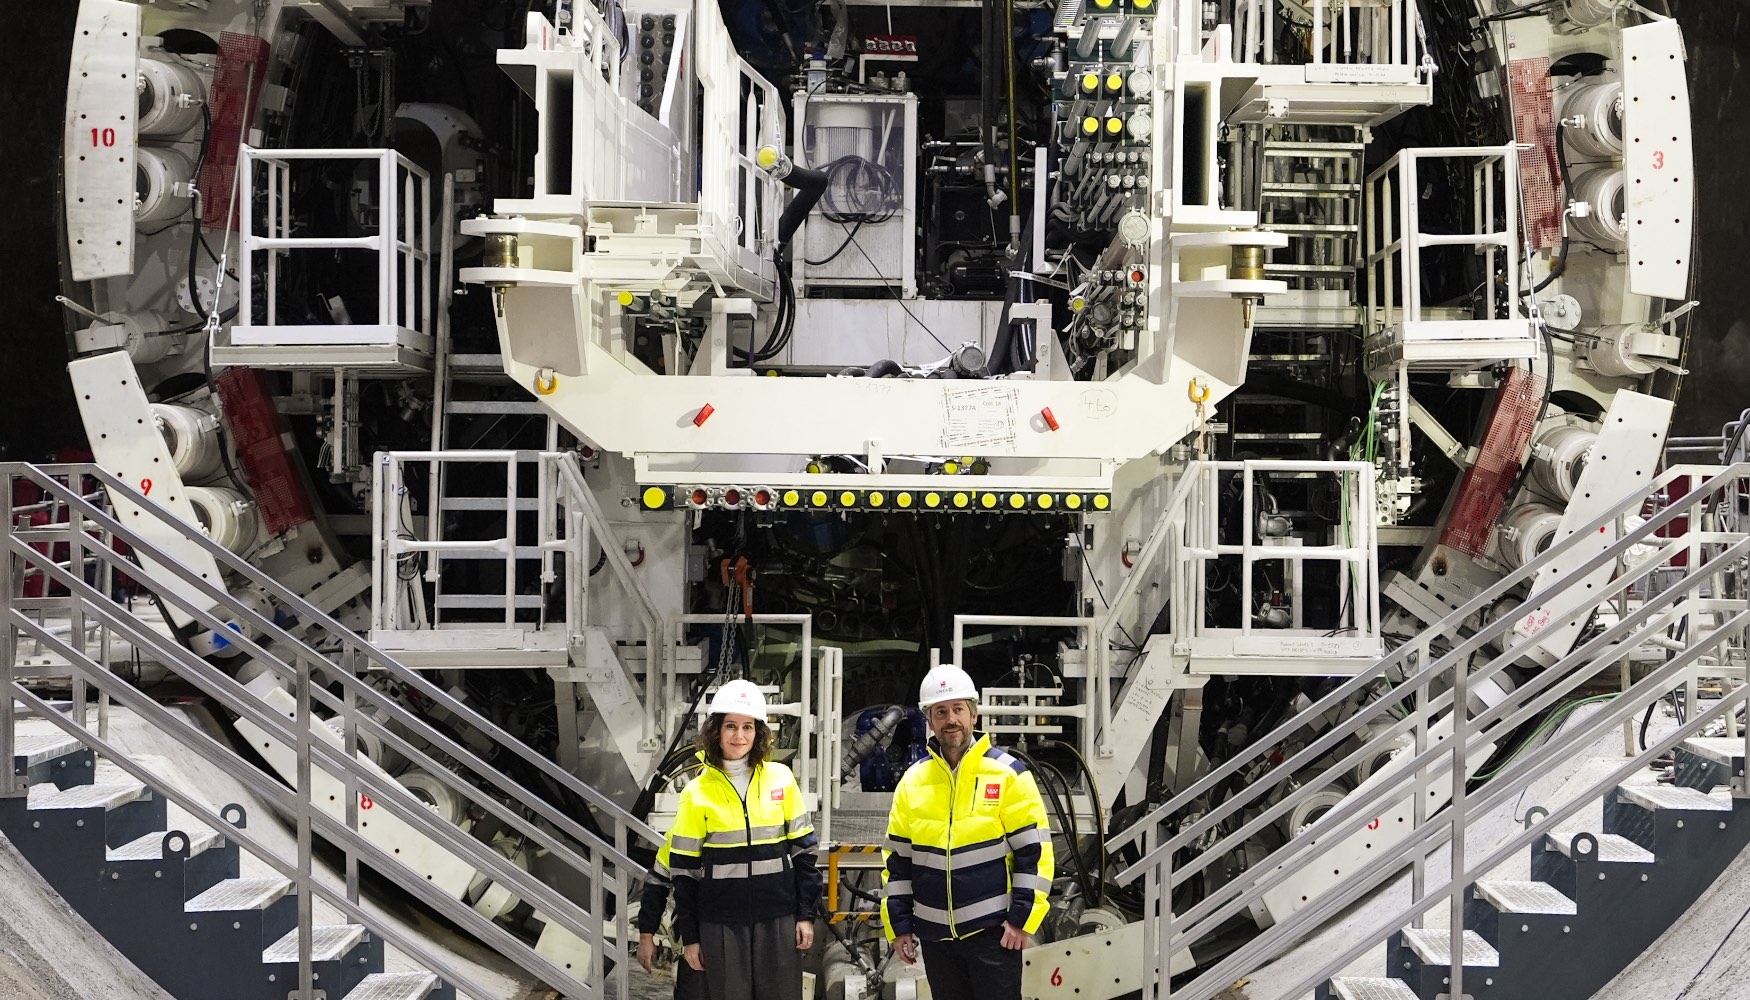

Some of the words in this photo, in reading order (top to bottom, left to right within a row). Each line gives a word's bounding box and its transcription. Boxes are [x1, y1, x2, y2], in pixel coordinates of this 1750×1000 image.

[91, 128, 115, 147] 10
[1652, 151, 1663, 169] 3
[141, 479, 152, 496] 9
[1051, 967, 1062, 986] 6
